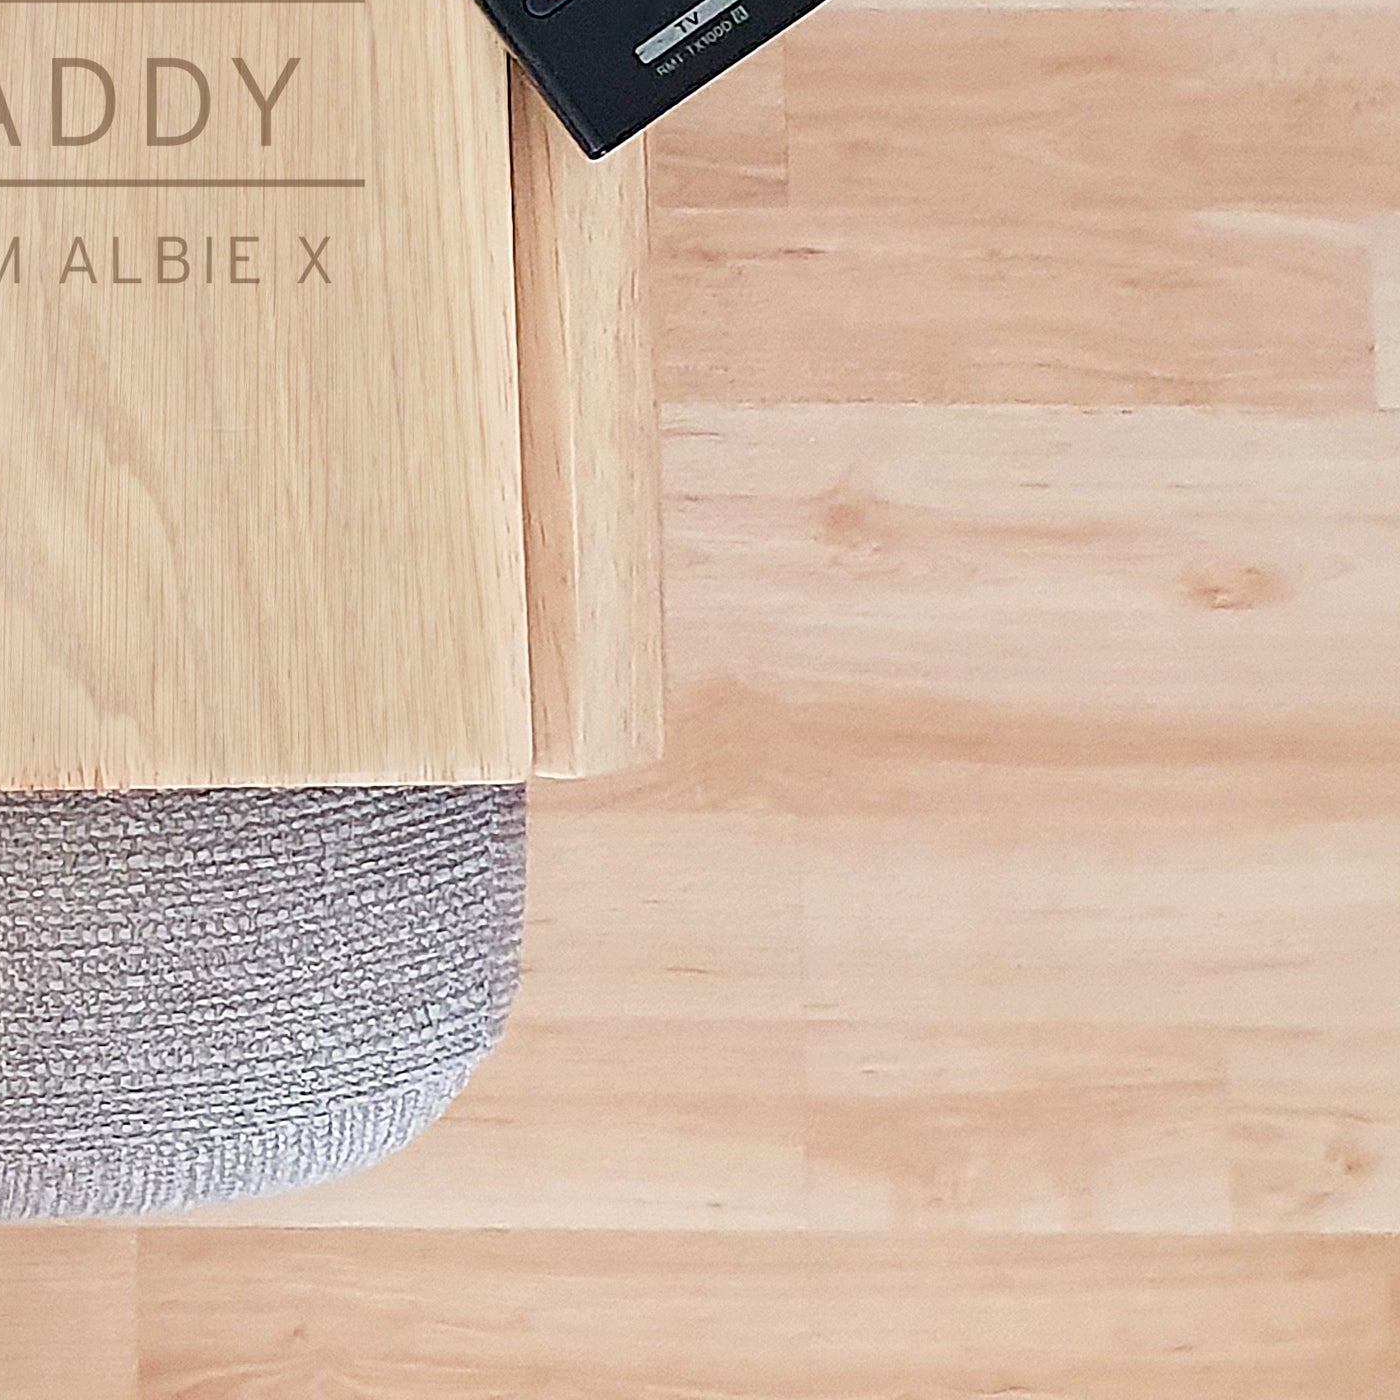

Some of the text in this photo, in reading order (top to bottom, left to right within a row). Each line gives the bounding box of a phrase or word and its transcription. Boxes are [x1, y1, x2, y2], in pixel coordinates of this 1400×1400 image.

[674, 11, 700, 34] TV
[58, 235, 263, 285] ALBIE
[297, 235, 334, 285] X
